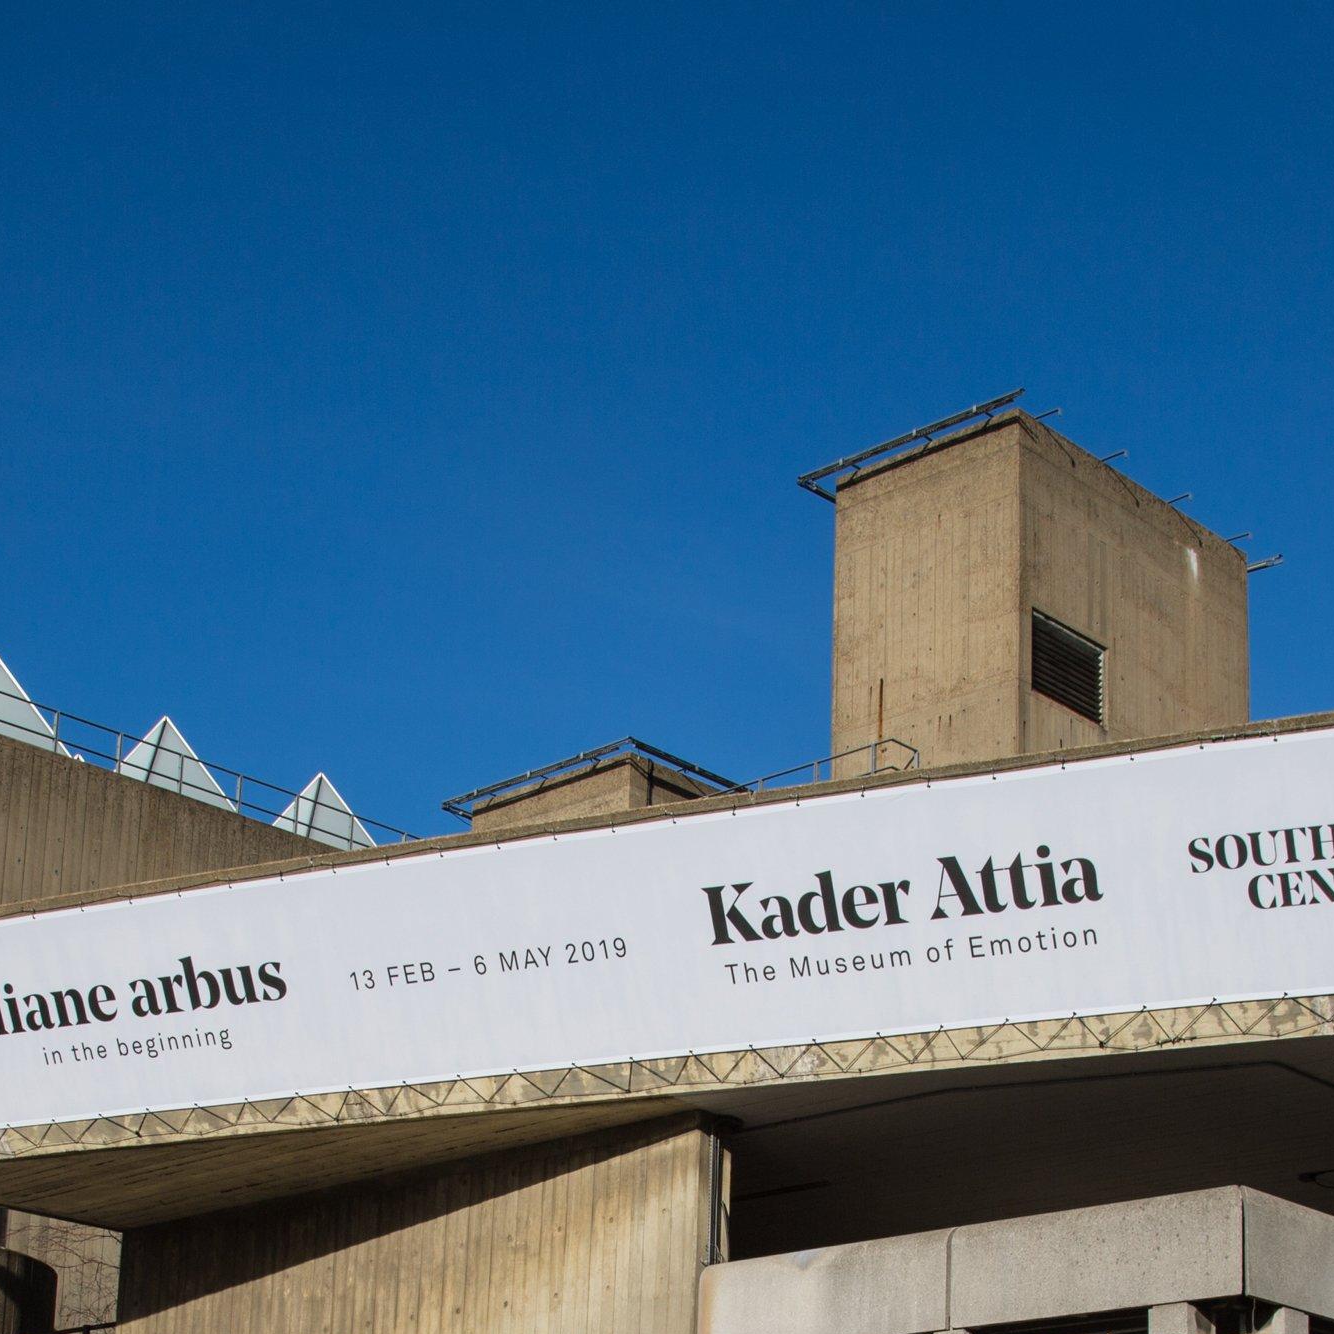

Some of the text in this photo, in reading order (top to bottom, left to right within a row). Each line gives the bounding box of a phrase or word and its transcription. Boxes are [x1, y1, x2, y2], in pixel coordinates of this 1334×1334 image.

[701, 844, 1104, 946] Kader Attia
[349, 969, 376, 991] 13
[386, 961, 436, 987] FEB
[473, 955, 487, 976] 6
[498, 945, 551, 972] MAY
[565, 937, 628, 964] 2019
[724, 928, 1099, 985] The Museum of Emotion
[129, 955, 288, 1018] arbus
[42, 1026, 234, 1065] in the beginning
